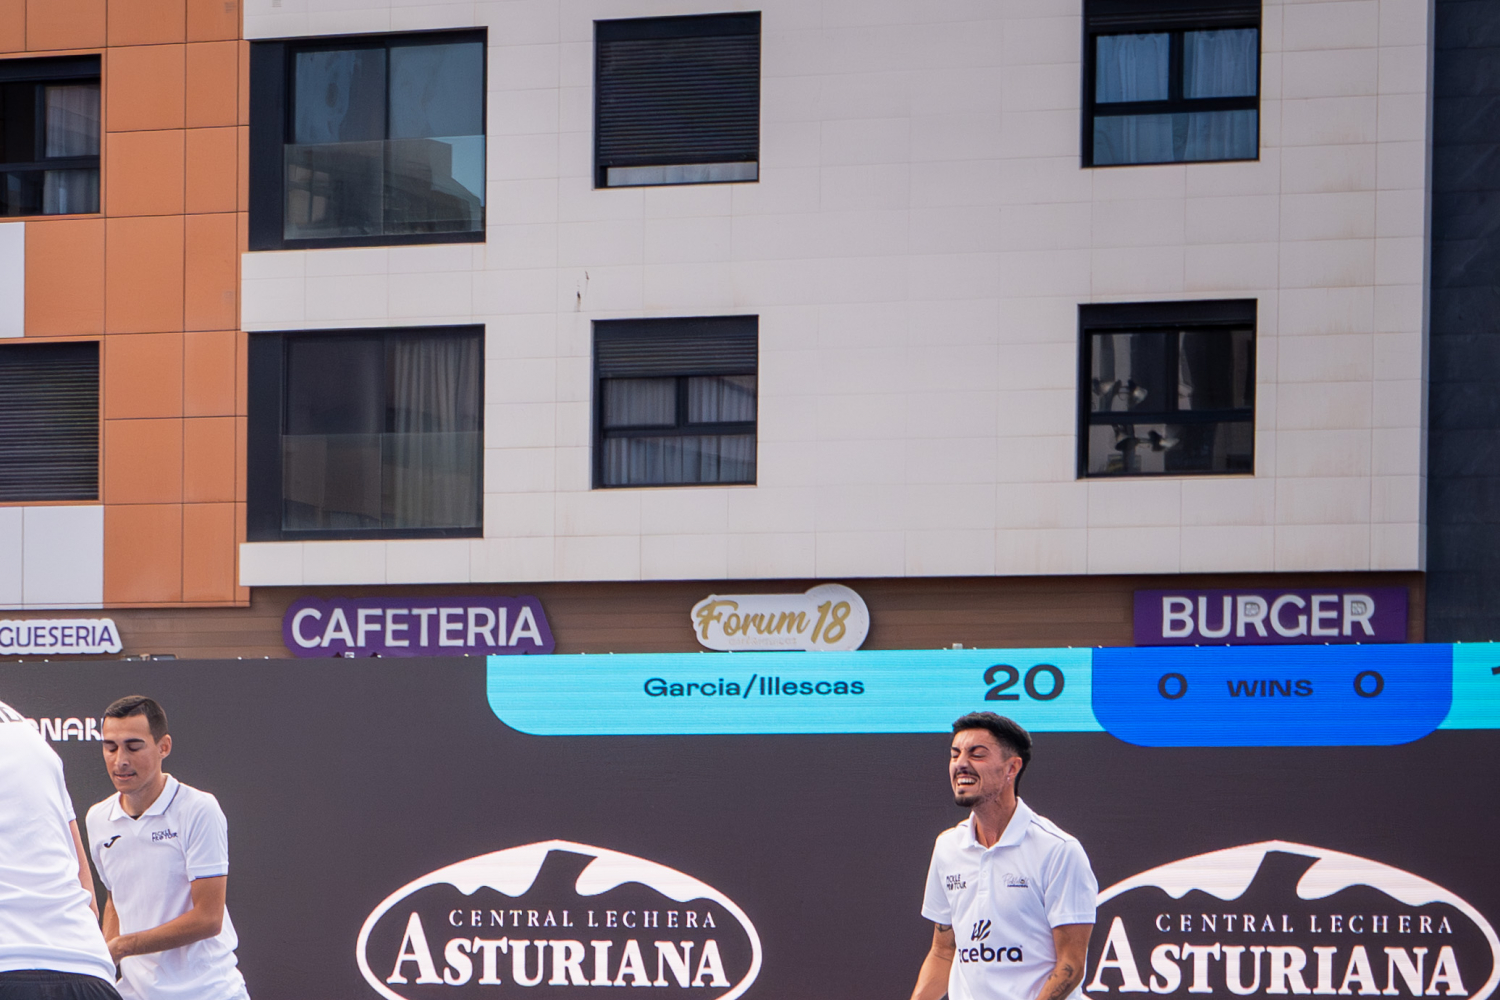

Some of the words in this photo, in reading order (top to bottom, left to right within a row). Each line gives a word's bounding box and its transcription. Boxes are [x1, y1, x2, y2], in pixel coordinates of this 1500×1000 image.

[291, 606, 544, 649] CAFETERIA
[696, 600, 810, 640] Forum
[811, 600, 851, 644] 18
[1162, 594, 1375, 638] BURGER
[644, 673, 865, 699] Garcia/Illescas
[984, 663, 1065, 701] 20
[1227, 679, 1313, 697] WINS
[448, 909, 574, 928] CENTRAL
[587, 910, 717, 929] LECHERA
[1155, 913, 1294, 933] CENTRAL
[1310, 914, 1454, 934] LECHERA
[387, 911, 731, 988] ASTURIANA
[1087, 916, 1468, 997] ASTURIANA
